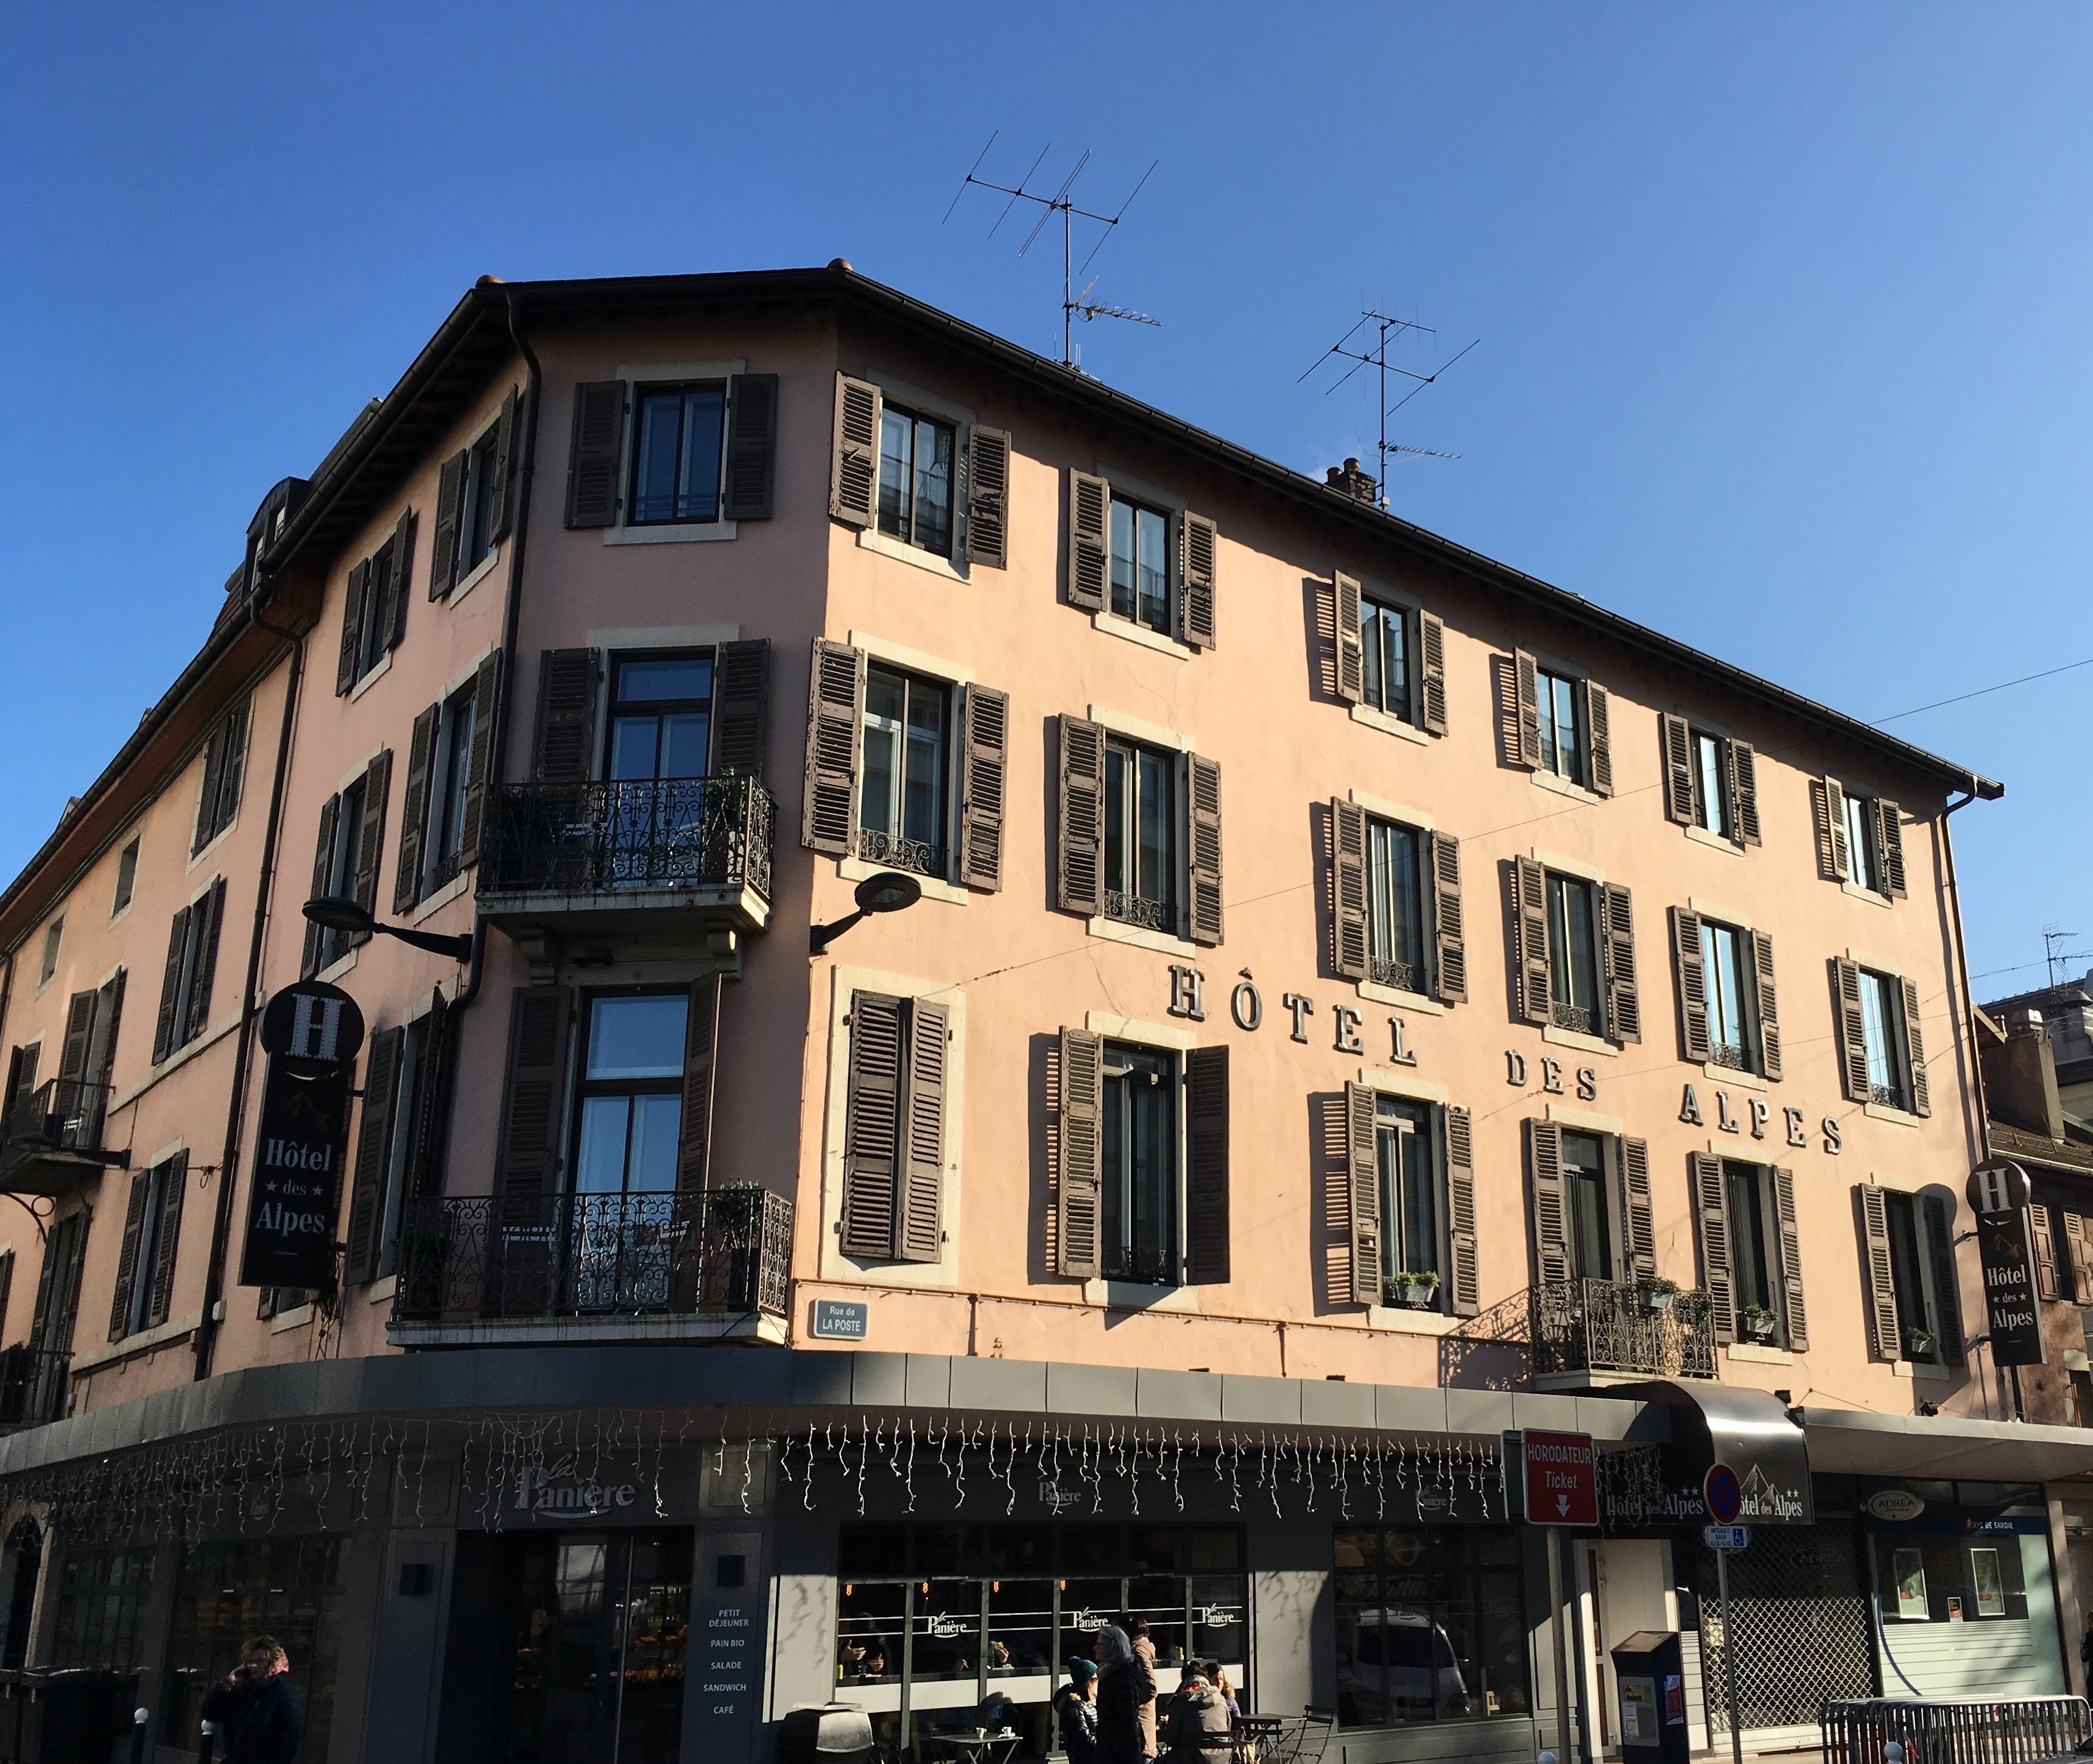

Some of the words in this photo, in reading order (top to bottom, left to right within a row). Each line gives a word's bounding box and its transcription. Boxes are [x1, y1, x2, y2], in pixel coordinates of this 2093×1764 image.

[285, 993, 345, 1061] H
[1168, 965, 1417, 1067] HÔTEL
[1505, 1049, 1597, 1101] DES
[1678, 1081, 1842, 1155] ALPES
[265, 1139, 331, 1171] Hôtel
[283, 1179, 306, 1195] des
[1975, 1167, 2013, 1214] H
[255, 1202, 325, 1237] Alpes
[1987, 1264, 2027, 1287] Hôtel
[2002, 1292, 2017, 1303] des
[829, 1305, 844, 1315] Rue
[846, 1307, 856, 1316] de
[1993, 1309, 2034, 1331] Alpes
[823, 1318, 833, 1330] LA
[835, 1319, 861, 1332] POSTE
[1527, 1443, 1592, 1464] HORODATEUR
[515, 1466, 636, 1509] Panière
[1546, 1471, 1577, 1488] Ticket
[1606, 1494, 1642, 1516] Hôtel
[1664, 1494, 1704, 1519] Alpes
[1761, 1501, 1772, 1515] des
[1775, 1494, 1803, 1520] Alpes
[1879, 1499, 1915, 1508] ADREA
[709, 1618, 749, 1627] DÉJEUNER
[927, 1615, 967, 1634] Panière
[1073, 1611, 1108, 1628] Panière
[1202, 1606, 1234, 1623] Panière
[714, 1705, 734, 1714] CAFÉ
